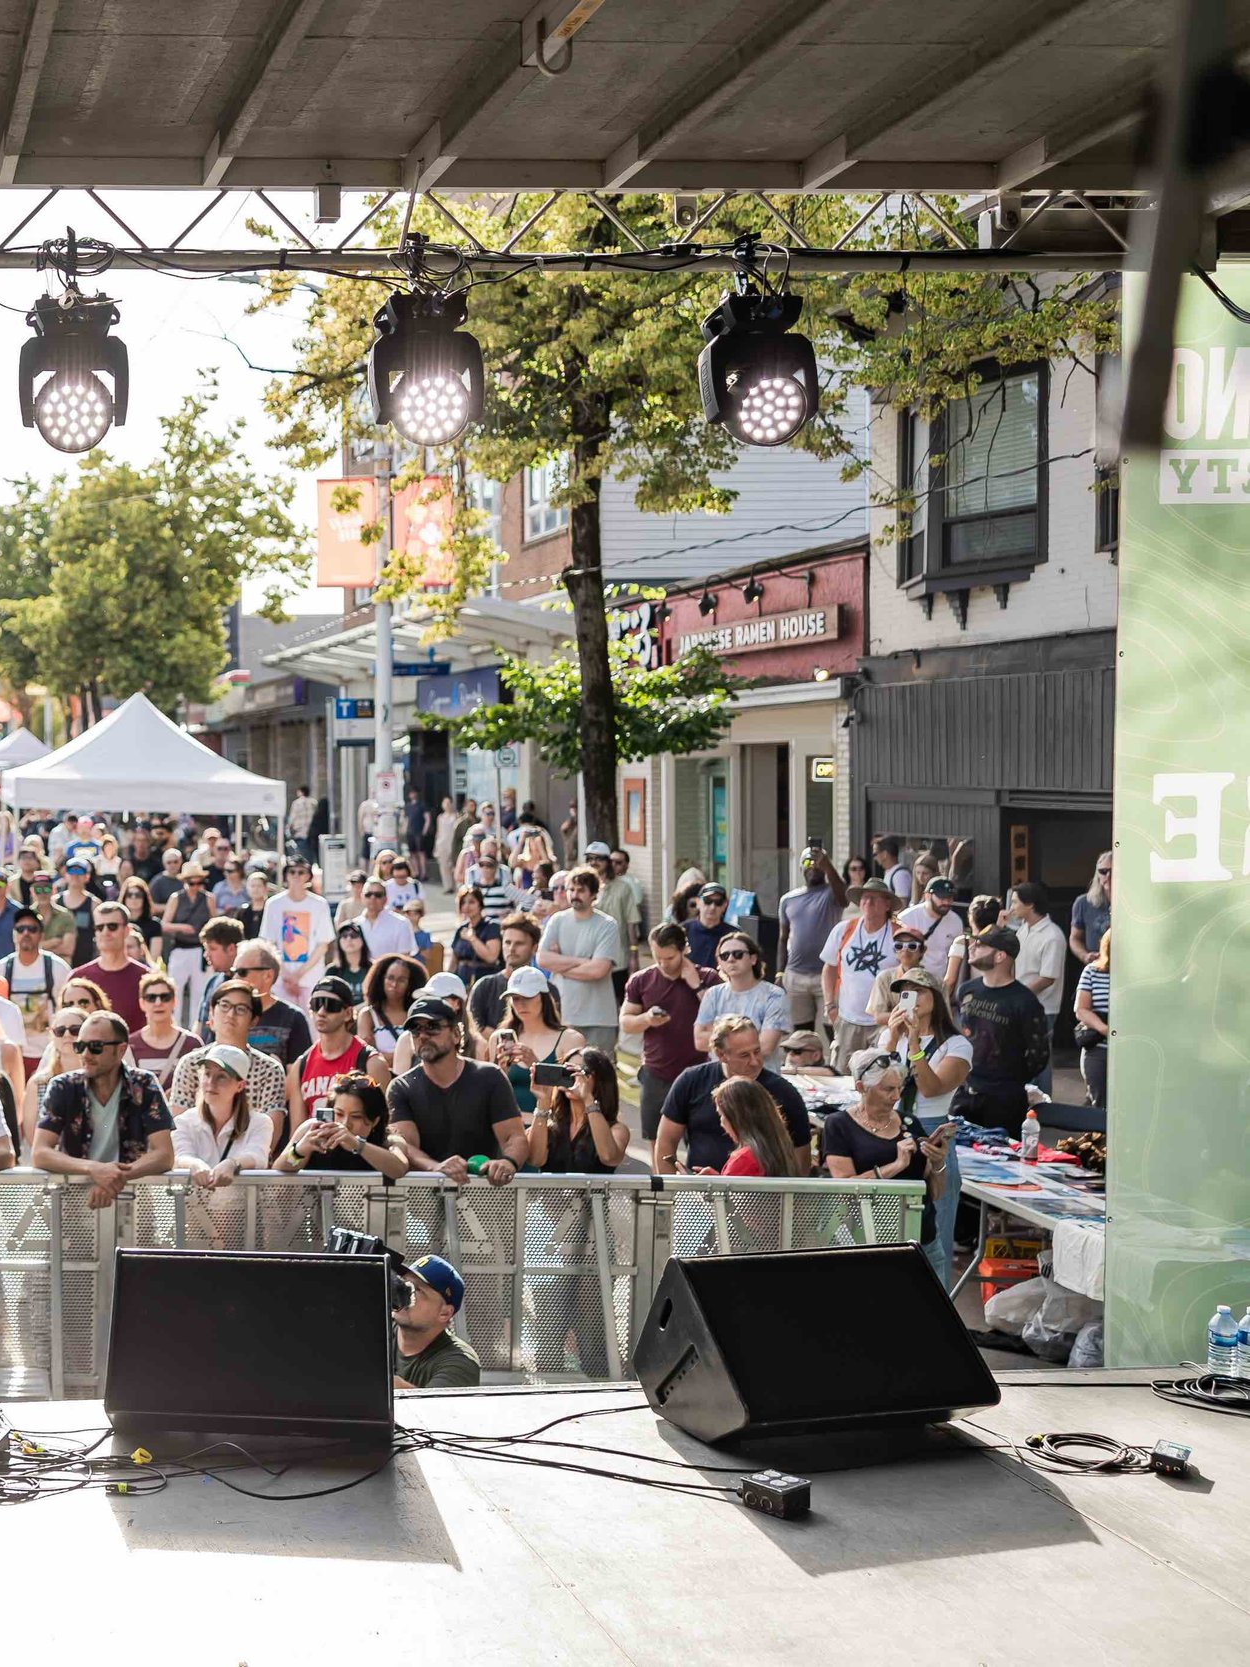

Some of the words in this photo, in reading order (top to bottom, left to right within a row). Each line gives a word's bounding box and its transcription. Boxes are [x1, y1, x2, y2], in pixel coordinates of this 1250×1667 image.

[735, 620, 776, 647] RAMEN
[779, 612, 825, 641] HOUSE
[340, 702, 350, 716] T
